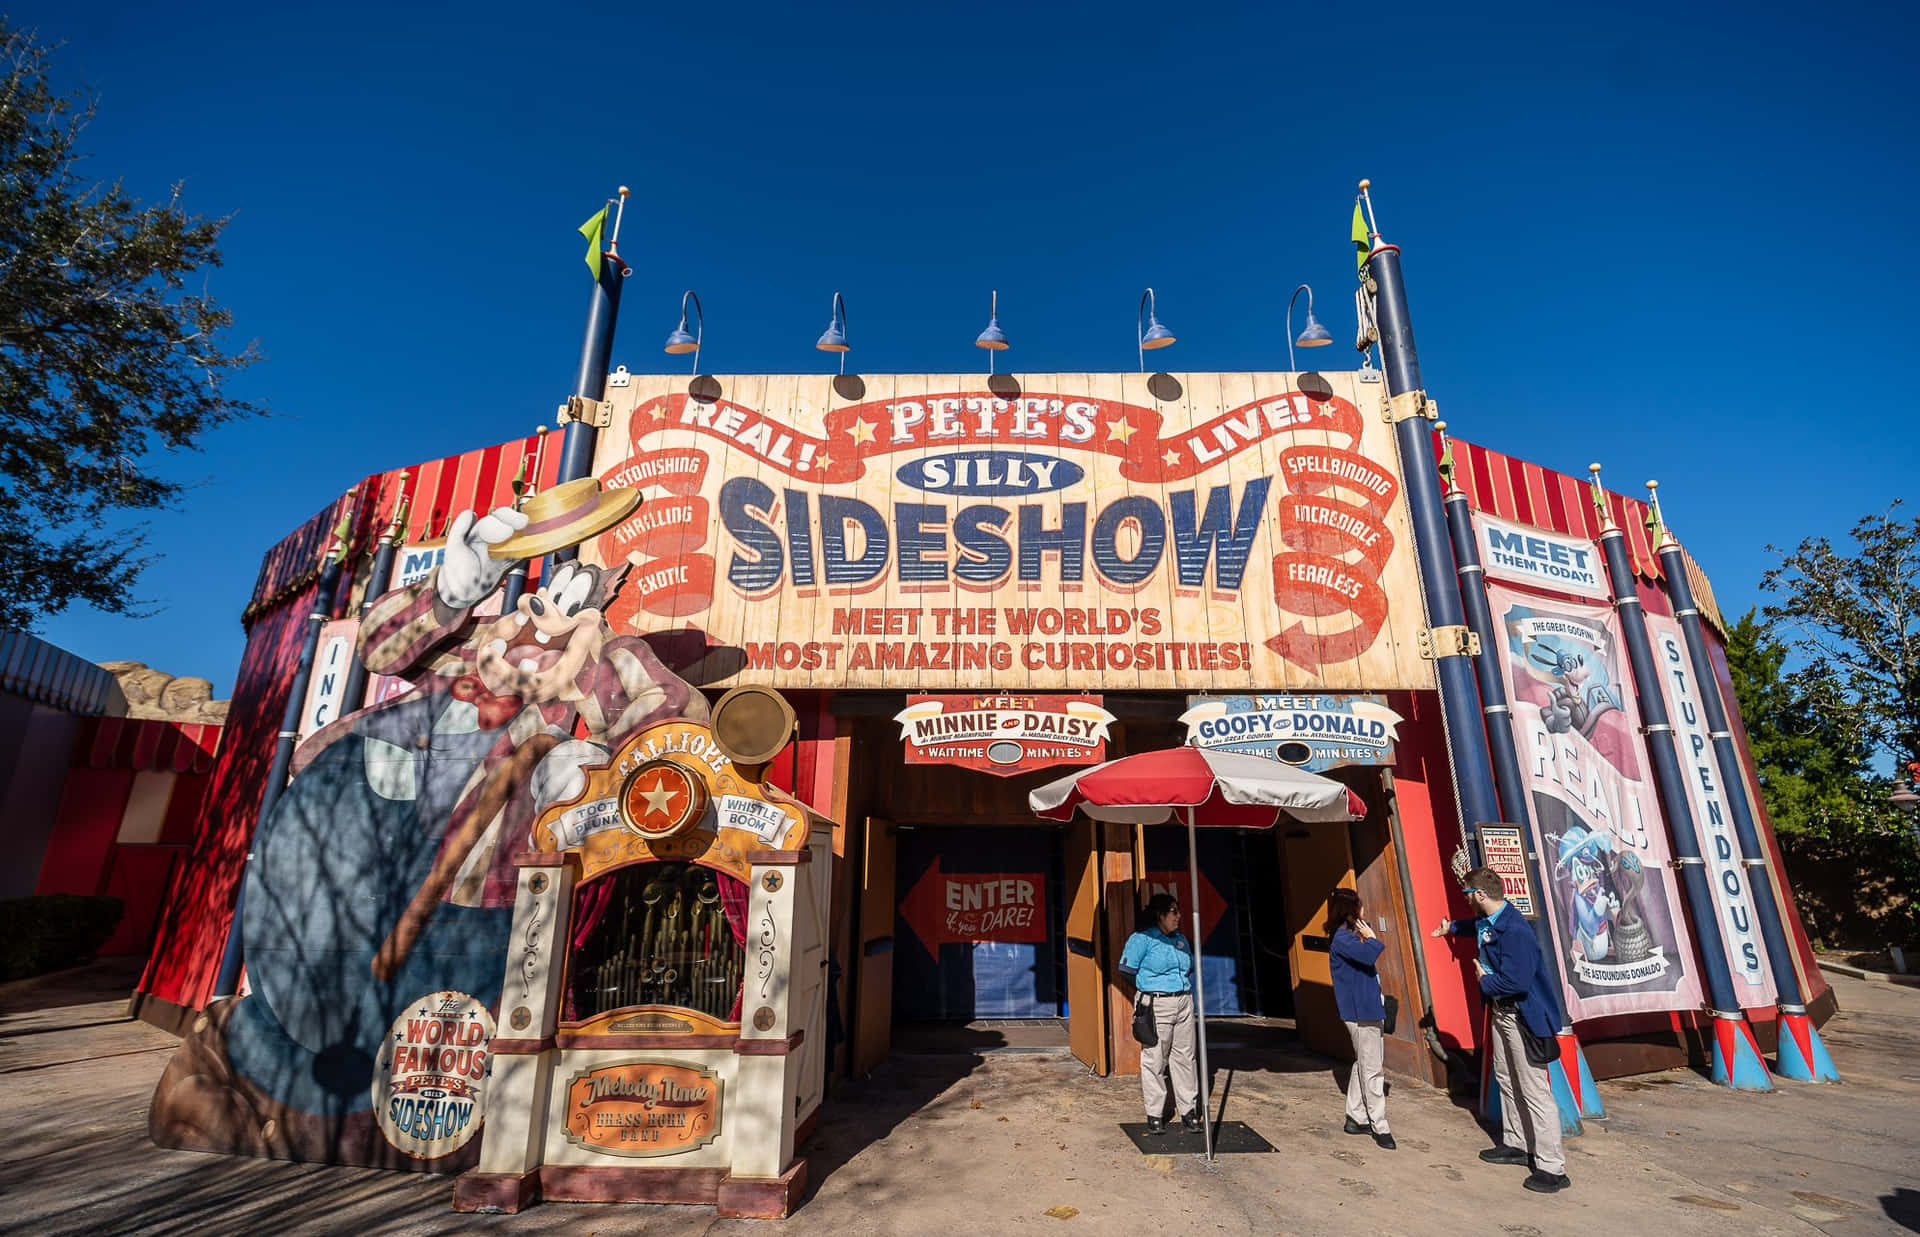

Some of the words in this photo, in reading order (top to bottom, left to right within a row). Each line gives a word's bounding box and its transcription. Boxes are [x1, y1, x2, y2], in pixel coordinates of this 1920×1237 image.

[679, 399, 818, 472] REAL!
[885, 397, 1100, 445] PETE'S
[1186, 397, 1313, 465] LIVE!
[606, 456, 701, 490] ASTONISHING
[922, 458, 1060, 489] SILLY
[1287, 454, 1393, 497] SPELLBINDING
[612, 505, 693, 545] THRILLING
[718, 474, 1275, 601] SIDESHOW
[1295, 504, 1382, 547] INCREDIBLE
[1487, 527, 1589, 569] MEET
[637, 565, 688, 596] EXOTIC
[1288, 563, 1364, 600] FEARLESS
[1492, 551, 1538, 572] THEM
[1540, 563, 1595, 584] TODAY!
[832, 607, 922, 635] MEET
[931, 607, 997, 635] THE
[1005, 607, 1162, 635] WORLD'S
[1532, 622, 1546, 632] THE
[1546, 622, 1566, 633] GREAT
[746, 642, 844, 671] MOST
[848, 642, 1013, 671] AMAZING
[1020, 642, 1252, 671] CURIOSITIES!
[973, 696, 1038, 710] MEET
[1255, 697, 1320, 710] MEET
[916, 713, 997, 738] MINNIE
[1002, 719, 1019, 729] AND
[1024, 713, 1098, 738] DAISY
[1199, 714, 1274, 739] GOOFY
[1293, 713, 1386, 739] DONALD
[618, 731, 732, 778] CALLIOPE
[928, 747, 955, 758] WAIT
[957, 747, 984, 758] TIME
[1026, 747, 1082, 758] MINUTES
[1315, 748, 1372, 759] MINUTES
[576, 801, 617, 818] TOOT
[727, 799, 779, 822] WHISTLE
[1665, 639, 1760, 970] STUPENDOUS
[729, 813, 767, 831] BOOM
[1490, 838, 1512, 846] MEET
[946, 879, 1035, 912] ENTER
[1501, 877, 1527, 895] DAY
[981, 907, 1035, 933] DARE!
[1592, 967, 1631, 981] ASTOUNDING
[1631, 962, 1662, 979] DONALDO
[407, 1018, 485, 1047] WORLD
[391, 1046, 487, 1081] FAMOUS
[410, 1076, 463, 1090] PETE'S
[580, 1072, 660, 1111] Melody
[660, 1077, 709, 1102] Time
[389, 1097, 474, 1141] SIDESHOW
